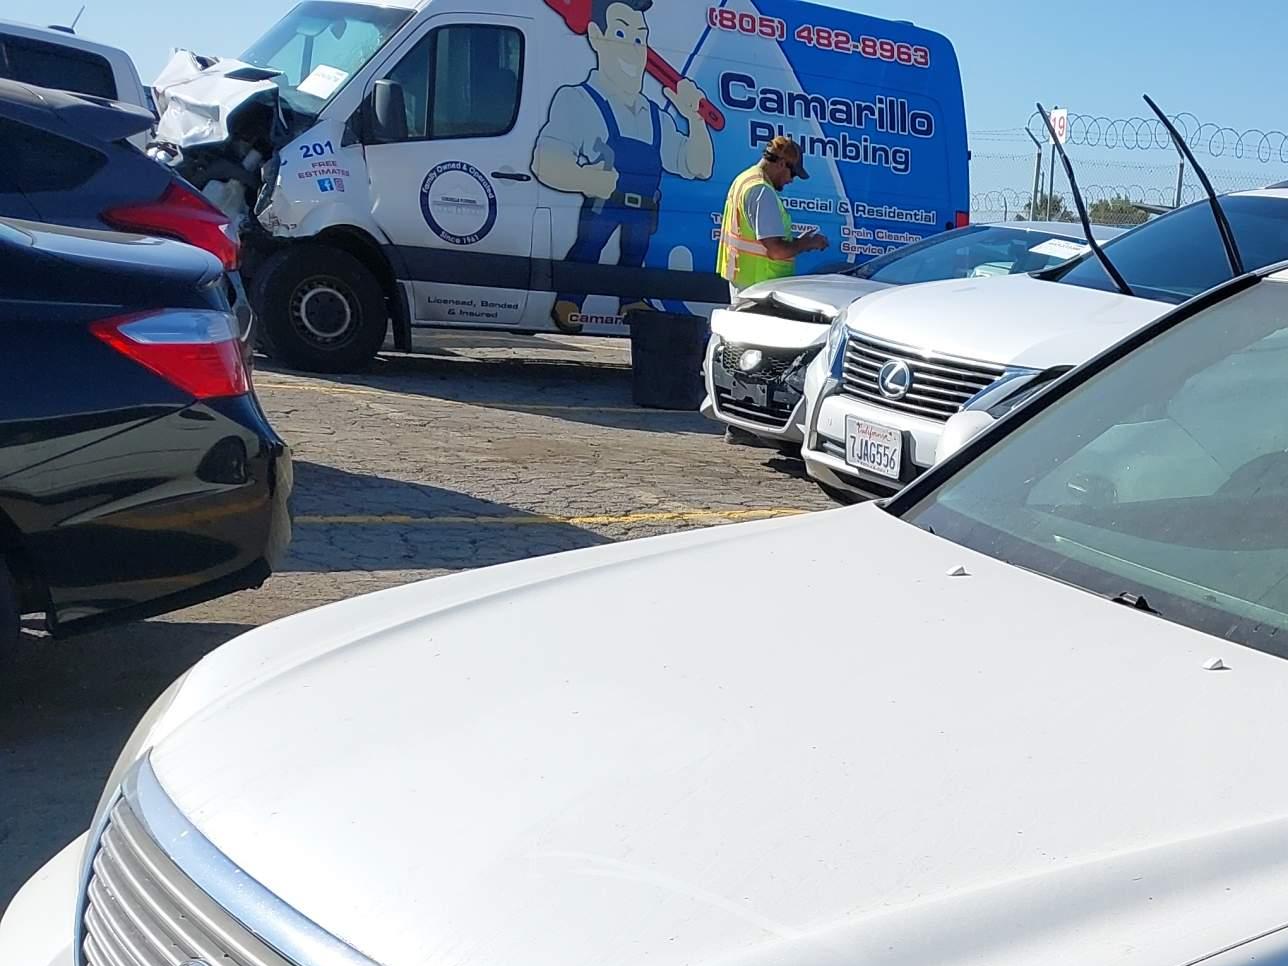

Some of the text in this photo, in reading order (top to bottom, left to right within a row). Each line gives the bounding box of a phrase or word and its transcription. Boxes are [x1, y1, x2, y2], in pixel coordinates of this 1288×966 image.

[708, 7, 930, 67] (805) 482-8963
[719, 71, 935, 137] Camarillo
[299, 140, 335, 158] 201
[311, 160, 338, 168] FREE
[837, 202, 850, 215] &
[855, 204, 936, 224] Residential
[841, 226, 874, 239] Drain
[841, 241, 884, 255] Service
[568, 312, 625, 326] camar
[849, 434, 897, 470] 7JAG556
